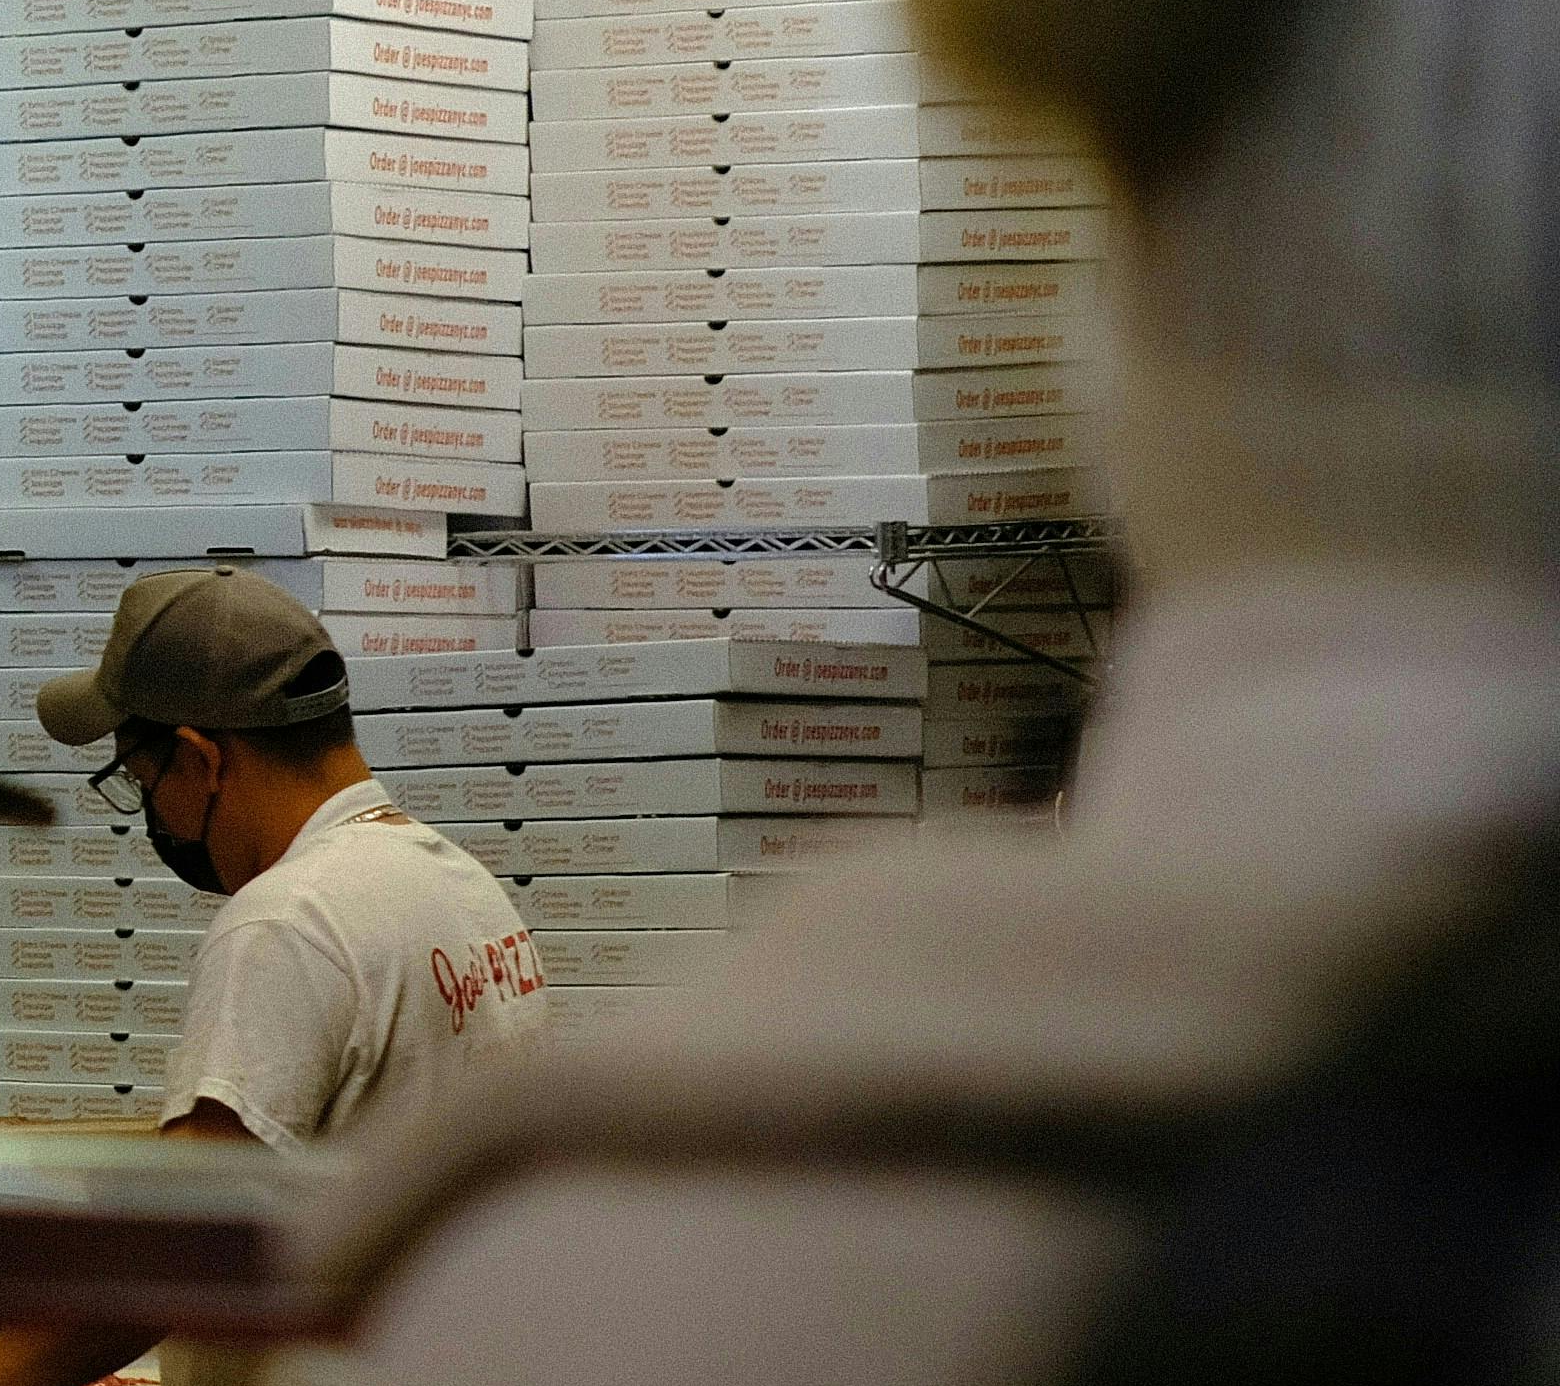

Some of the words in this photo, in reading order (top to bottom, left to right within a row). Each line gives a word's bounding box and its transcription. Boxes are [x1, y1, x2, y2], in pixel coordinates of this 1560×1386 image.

[373, 43, 399, 63] Order
[402, 46, 411, 68] @
[412, 46, 488, 75] joespizzanyc.com
[372, 97, 398, 118] Order
[400, 101, 409, 122] @
[410, 101, 488, 128] joespizzanyc.com
[370, 152, 396, 172] Order
[398, 155, 408, 176] @
[409, 155, 488, 182] joespizzanyc.com
[374, 205, 400, 226] Order
[403, 209, 412, 230] @
[413, 209, 489, 235] joespizzanyc.com
[962, 229, 985, 247] Order
[376, 259, 401, 279] Order
[403, 261, 412, 283] @
[413, 263, 488, 288] joespizzanyc.com
[957, 282, 980, 300] Order
[380, 313, 404, 333] Order
[406, 316, 414, 337] @
[415, 317, 488, 342] joespizzanyc.com
[376, 367, 401, 387] Order
[403, 371, 412, 392] @
[413, 371, 486, 398] joespizzanyc.com
[372, 421, 398, 441] Order
[400, 424, 409, 445] @
[410, 425, 484, 451] joespizzanyc.com
[959, 439, 981, 458] Order
[376, 476, 400, 495] Order
[402, 479, 411, 500] @
[412, 480, 486, 503] joespizzanyc.com
[365, 579, 390, 599] Order
[392, 581, 402, 602] @
[403, 581, 476, 604] joespizzanyc.com
[362, 633, 388, 652] Order
[391, 634, 399, 655] @
[774, 657, 800, 677] Order
[803, 658, 811, 682] @
[813, 658, 888, 683] joespizzanyc.com
[761, 719, 788, 741] Order
[791, 719, 799, 743] @
[802, 719, 881, 744] joespizzanyc.com
[765, 778, 790, 799] Order
[792, 780, 800, 802] @
[802, 779, 878, 802] joespizzanyc.com
[760, 836, 786, 855] Order
[485, 931, 545, 1001] PIZZ
